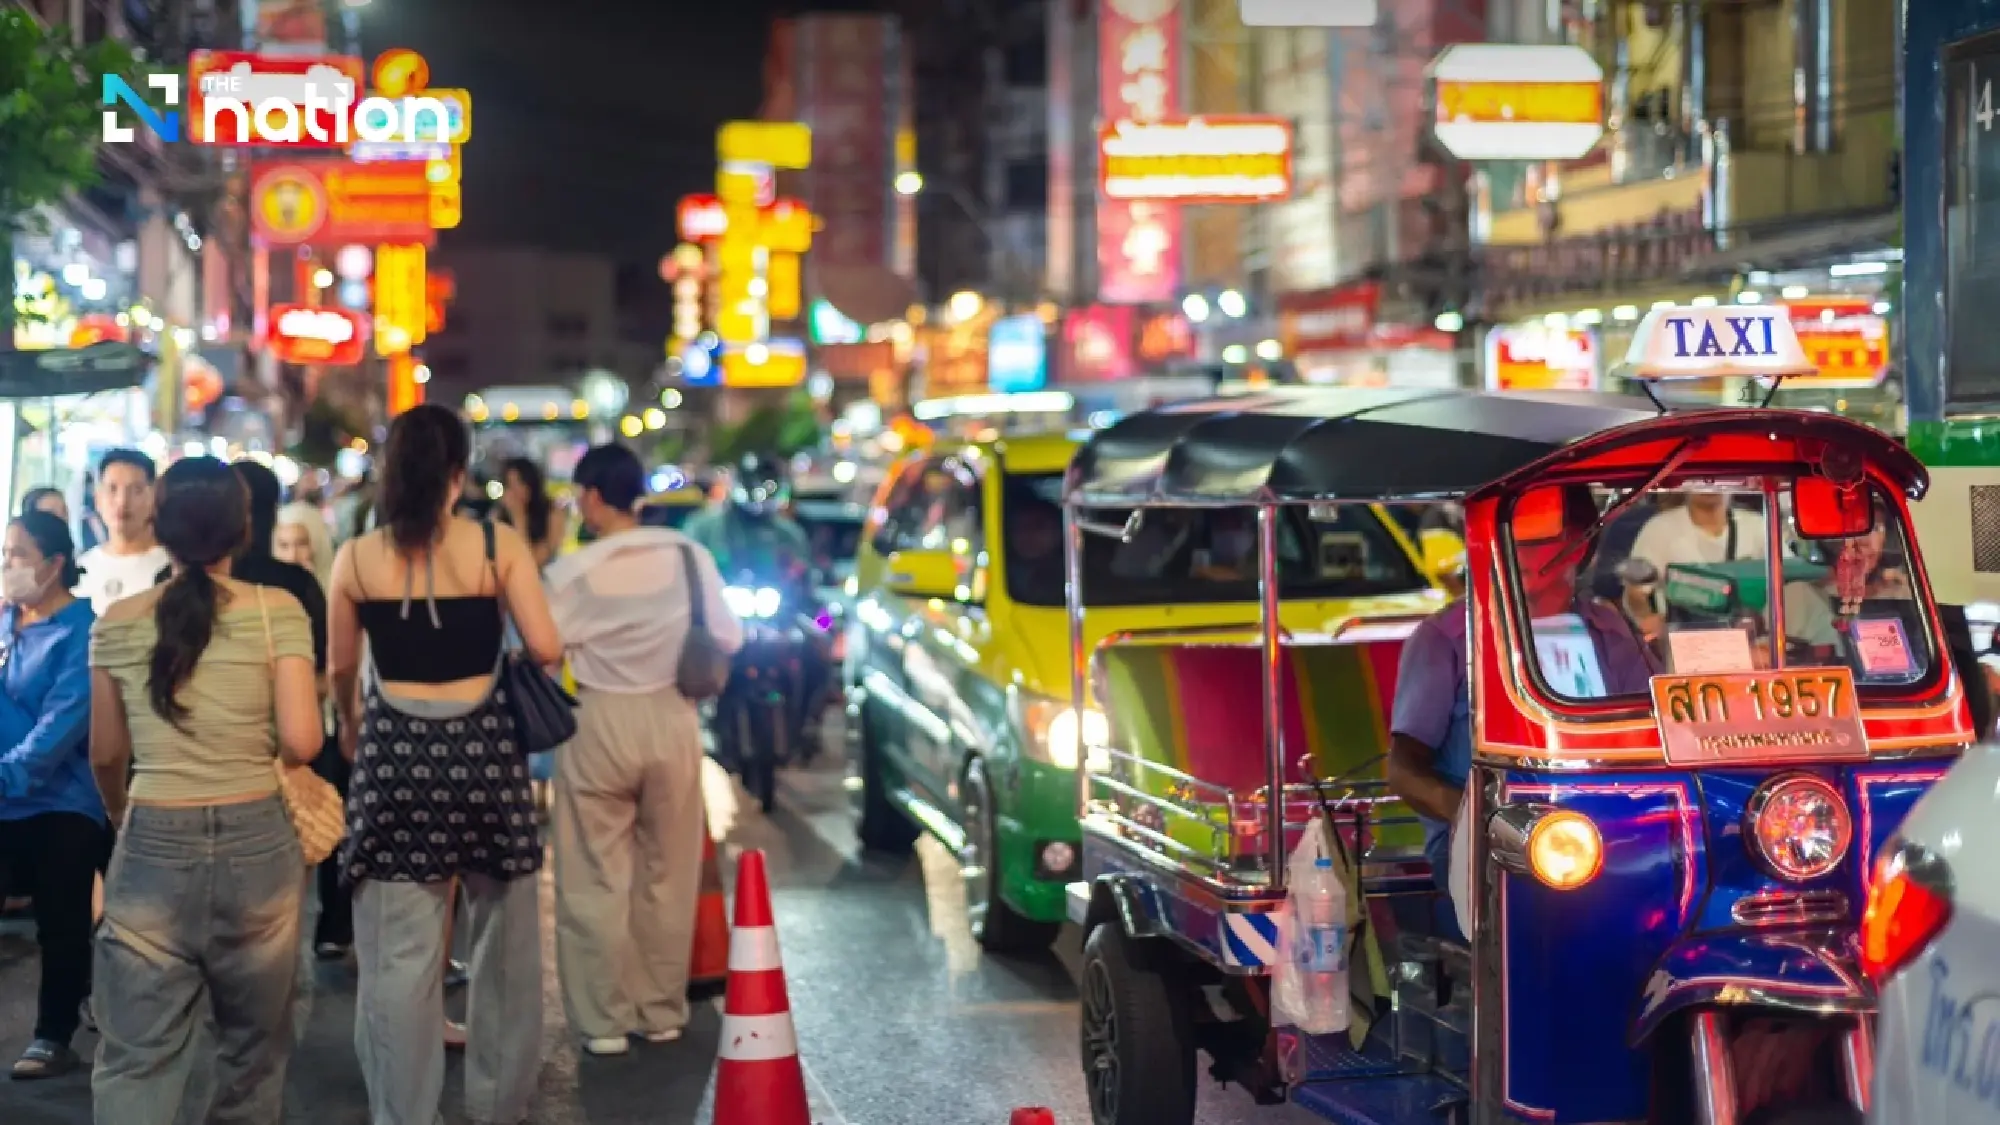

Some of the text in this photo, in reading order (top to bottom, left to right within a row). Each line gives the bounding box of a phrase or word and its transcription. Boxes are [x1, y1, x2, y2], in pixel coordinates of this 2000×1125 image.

[1665, 316, 1778, 356] TAXI
[1667, 674, 1842, 723] สก 1957
